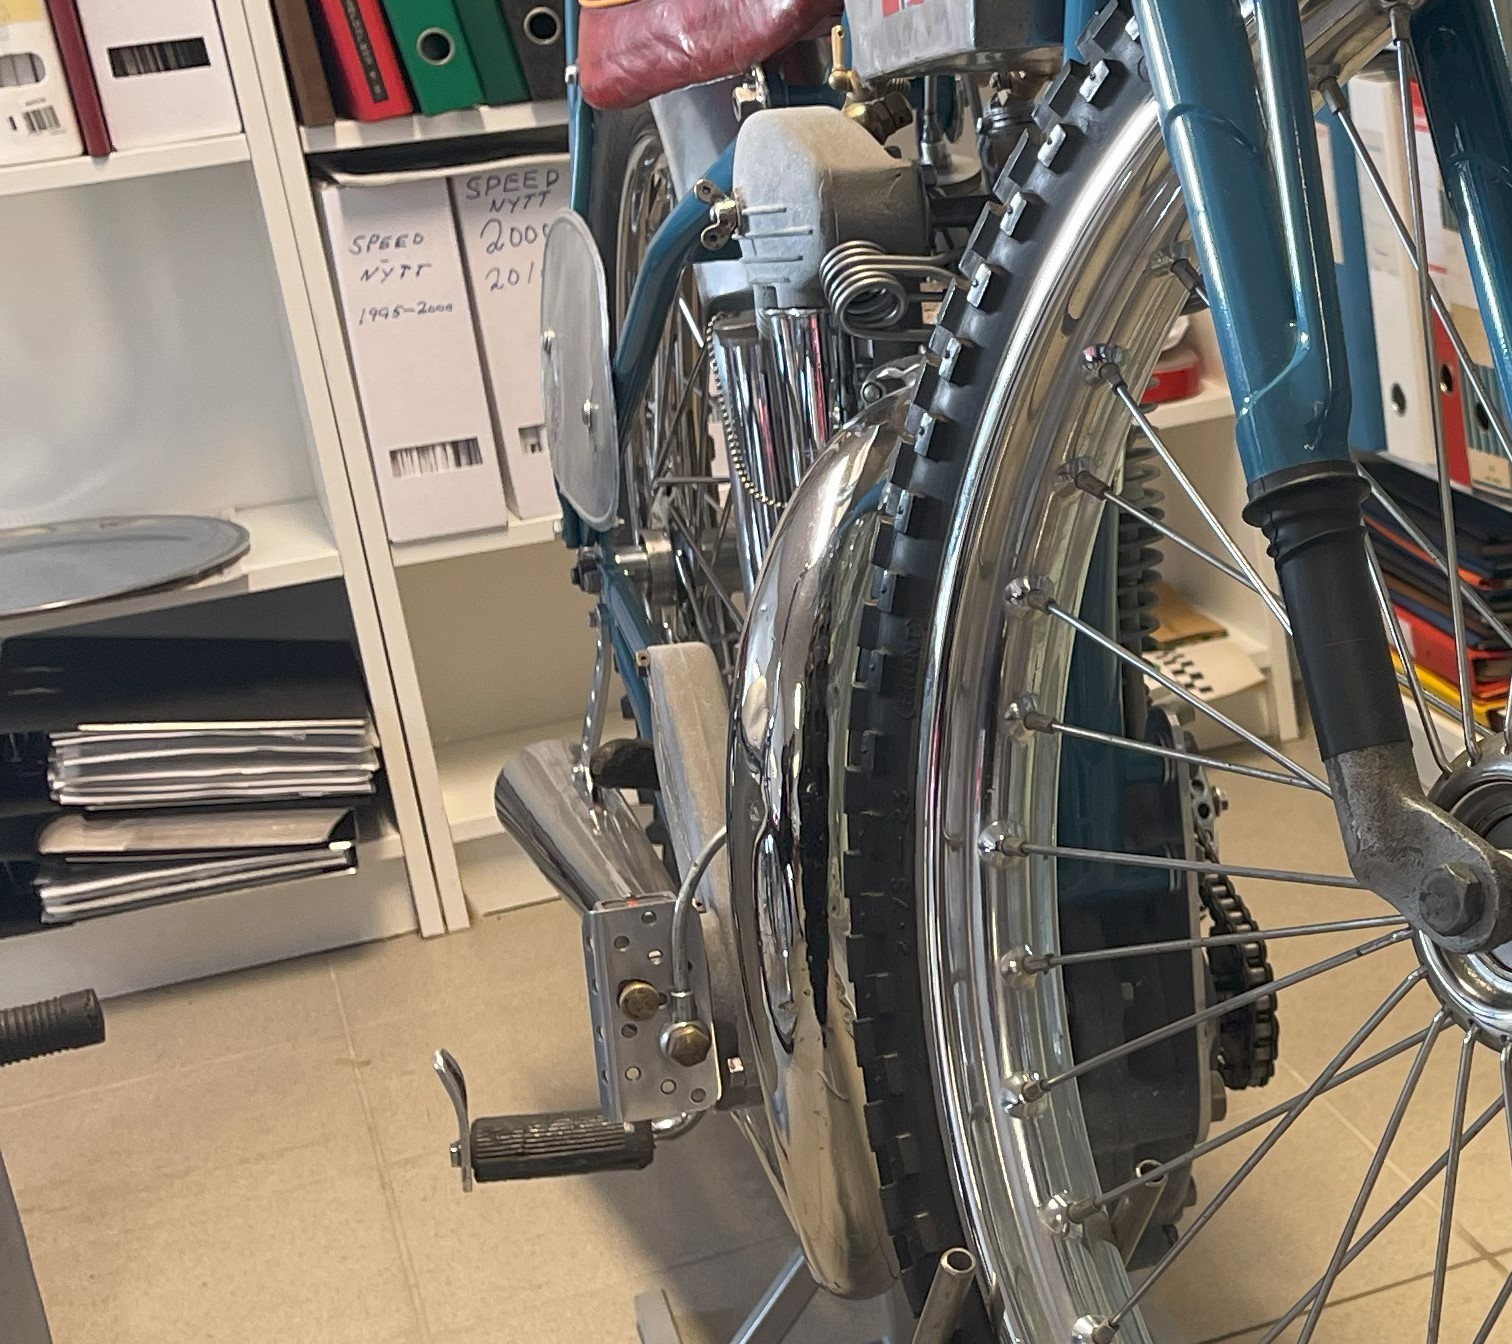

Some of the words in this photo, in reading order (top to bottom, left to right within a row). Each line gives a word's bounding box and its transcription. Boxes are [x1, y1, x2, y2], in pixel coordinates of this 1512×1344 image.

[466, 168, 560, 200] SPEED
[489, 188, 551, 214] NYTT
[349, 232, 425, 256] SPEED
[360, 262, 432, 284] NYTT
[485, 260, 542, 292] 201
